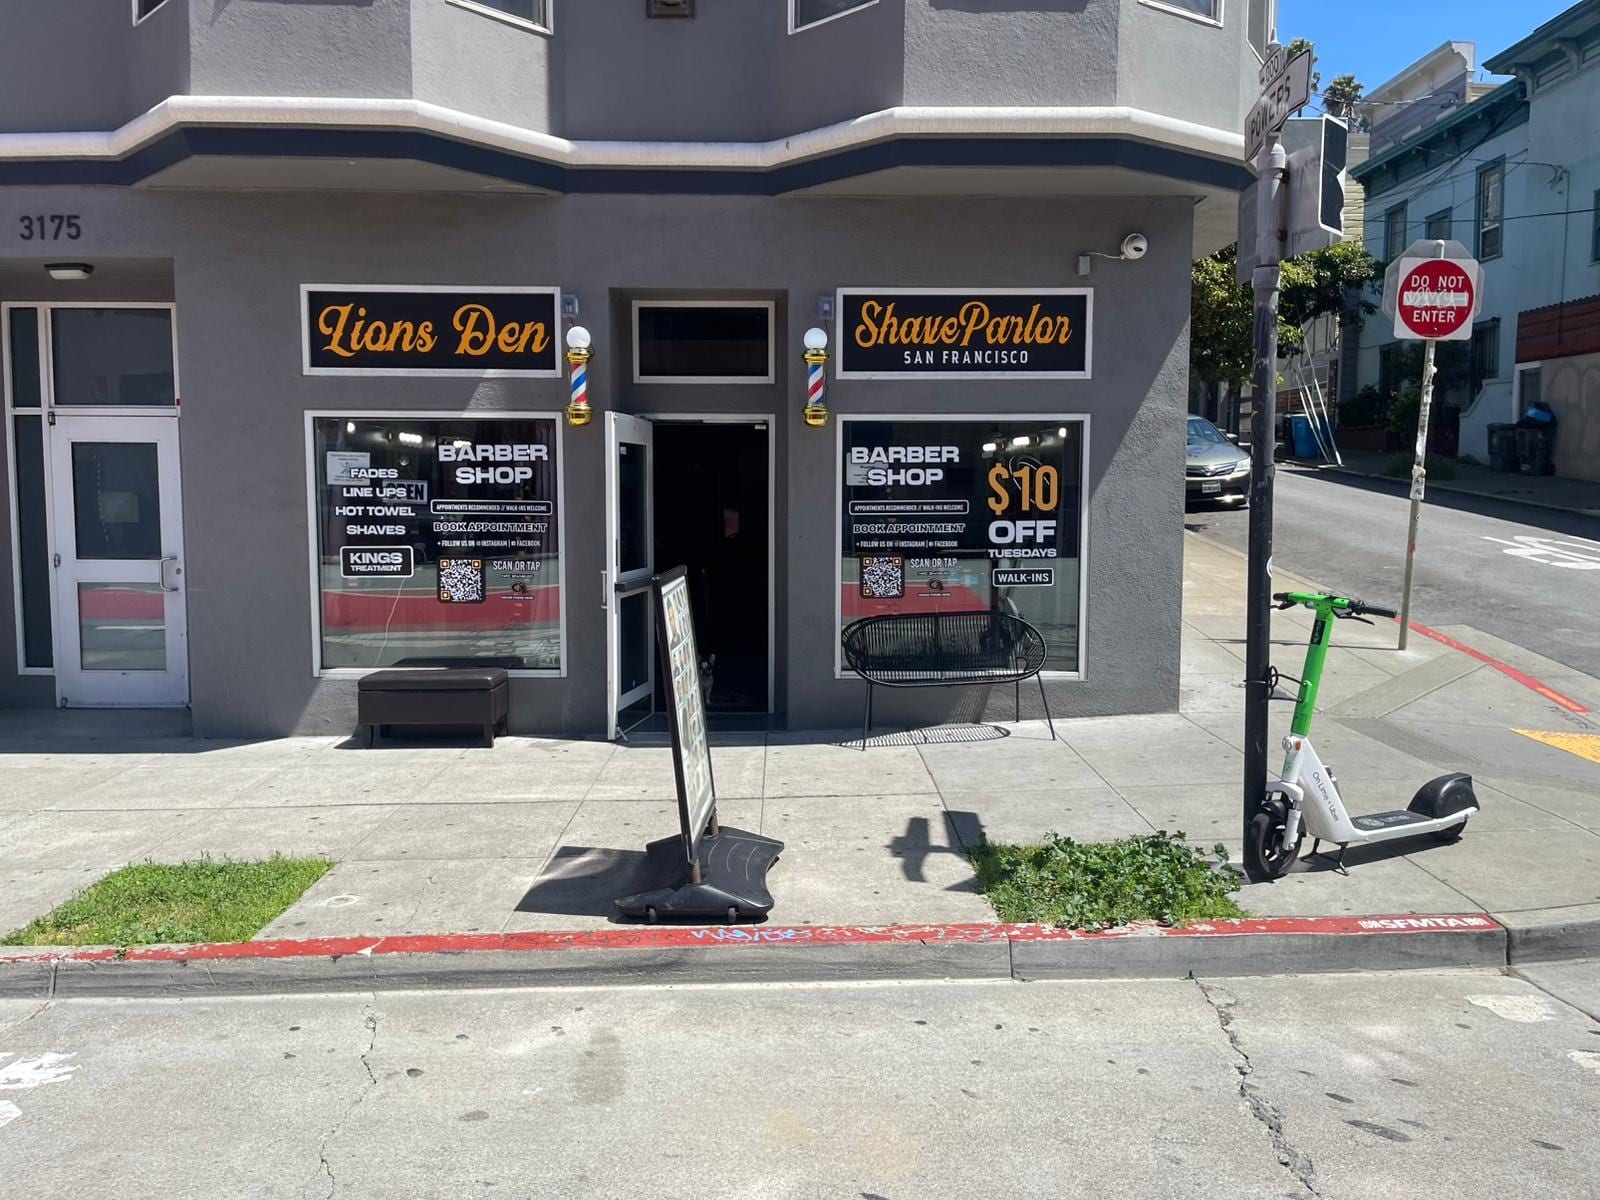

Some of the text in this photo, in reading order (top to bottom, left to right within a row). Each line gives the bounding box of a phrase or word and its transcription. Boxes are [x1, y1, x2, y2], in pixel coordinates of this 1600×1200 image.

[19, 214, 82, 241] 3175
[1411, 275, 1465, 288] DO NOT
[1413, 310, 1456, 323] ENTER
[318, 303, 550, 357] Lions Den
[903, 350, 1028, 364] SAN FRANCISCO
[438, 444, 549, 462] BARBER
[851, 446, 960, 463] BARBER
[350, 468, 399, 479] FADES
[455, 466, 533, 484] SHOP
[867, 468, 944, 486] SHOP
[342, 487, 407, 497] LINE UPS
[987, 462, 1058, 515] $10
[335, 506, 416, 516] HOT TOWEL
[346, 525, 406, 535] SHAVES
[433, 522, 548, 533] BOOK APPOINTMENT
[853, 523, 966, 533] BOOK APPOINTMENT
[988, 520, 1057, 544] OFF
[934, 540, 958, 548] FACEBOOK
[349, 552, 404, 564] KINGS
[988, 548, 1057, 558] TUESDAYS
[493, 560, 541, 571] SCAN OR TAP
[910, 558, 958, 568] SCAN OR TAP
[997, 573, 1049, 583] WALK-INS
[1312, 771, 1320, 784] On
[1318, 782, 1329, 800] Lime
[1329, 804, 1340, 821] Uber
